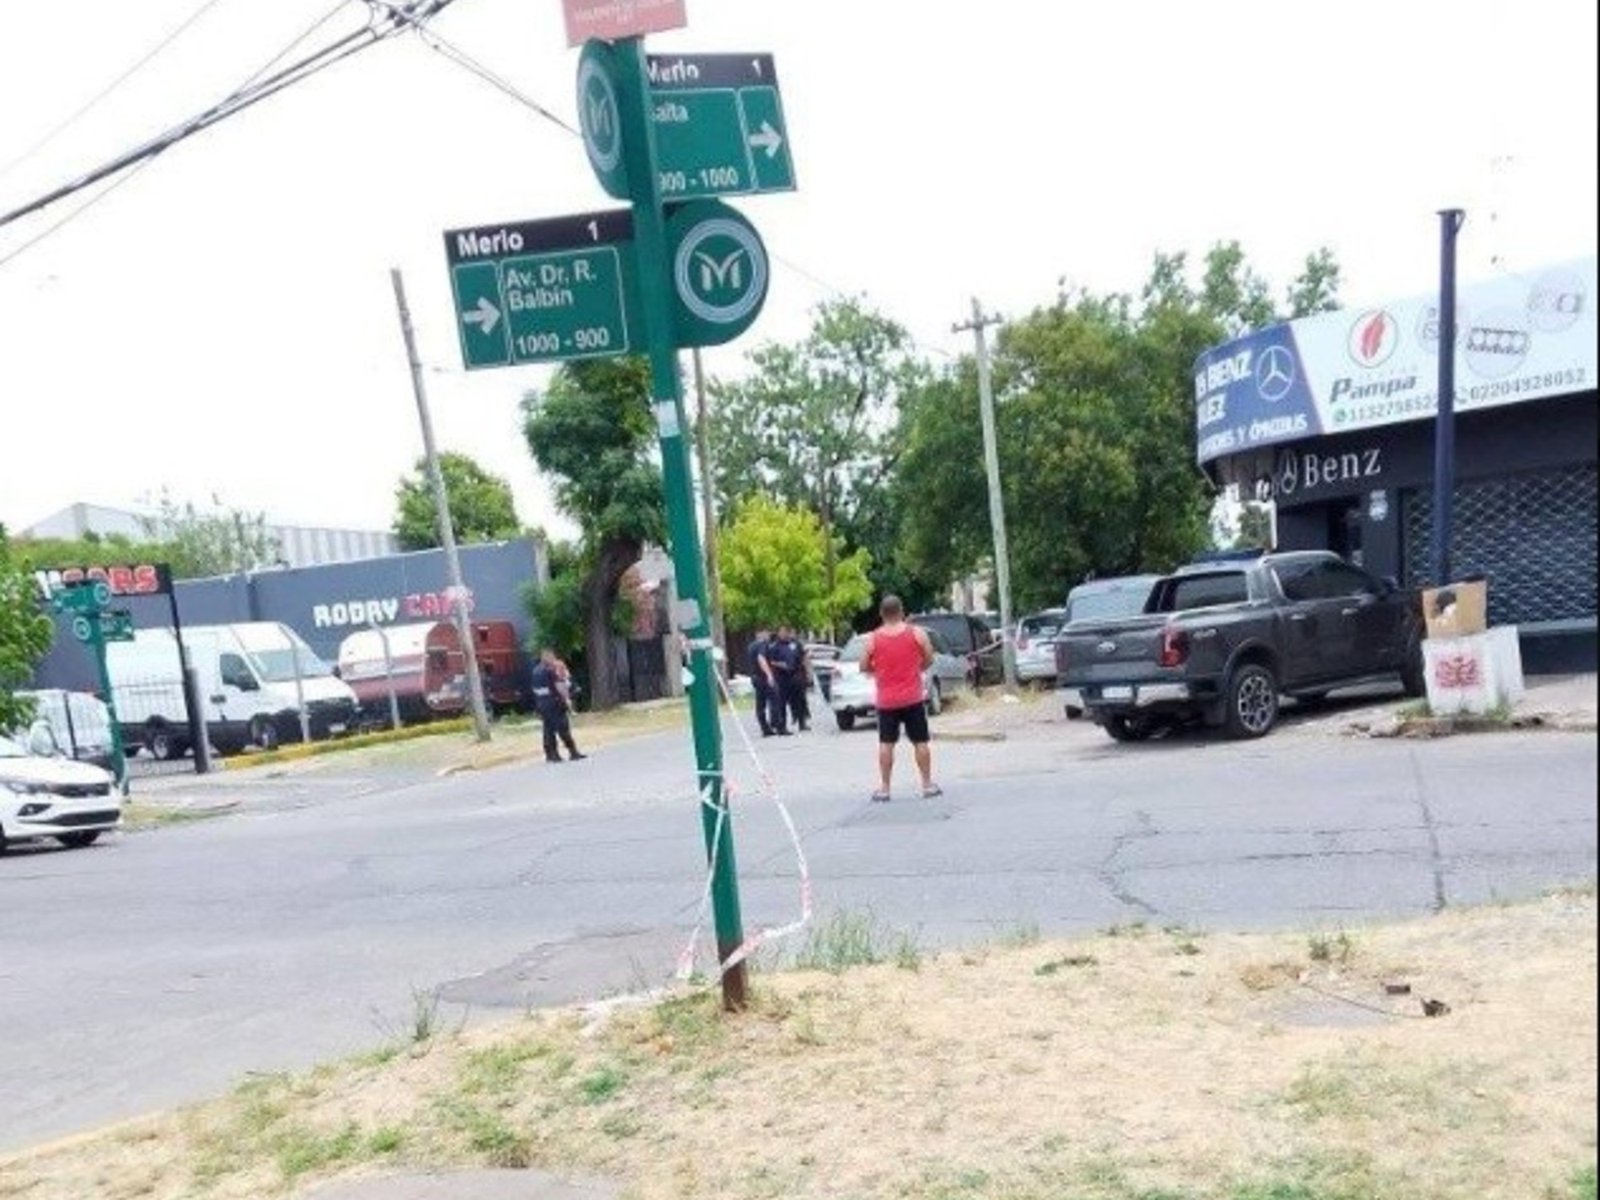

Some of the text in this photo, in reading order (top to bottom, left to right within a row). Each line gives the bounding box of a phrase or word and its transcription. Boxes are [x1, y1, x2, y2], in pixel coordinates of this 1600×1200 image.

[752, 59, 762, 79] 1
[701, 166, 739, 188] 1000
[456, 220, 599, 258] Merlo 1
[506, 259, 597, 289] Av. Dr. R.
[517, 331, 560, 355] 1000
[575, 327, 609, 349] 900
[1207, 349, 1252, 394] BENZ
[1329, 376, 1418, 404] Pampa
[1303, 449, 1382, 488] Benz
[313, 597, 399, 628] RODRY
